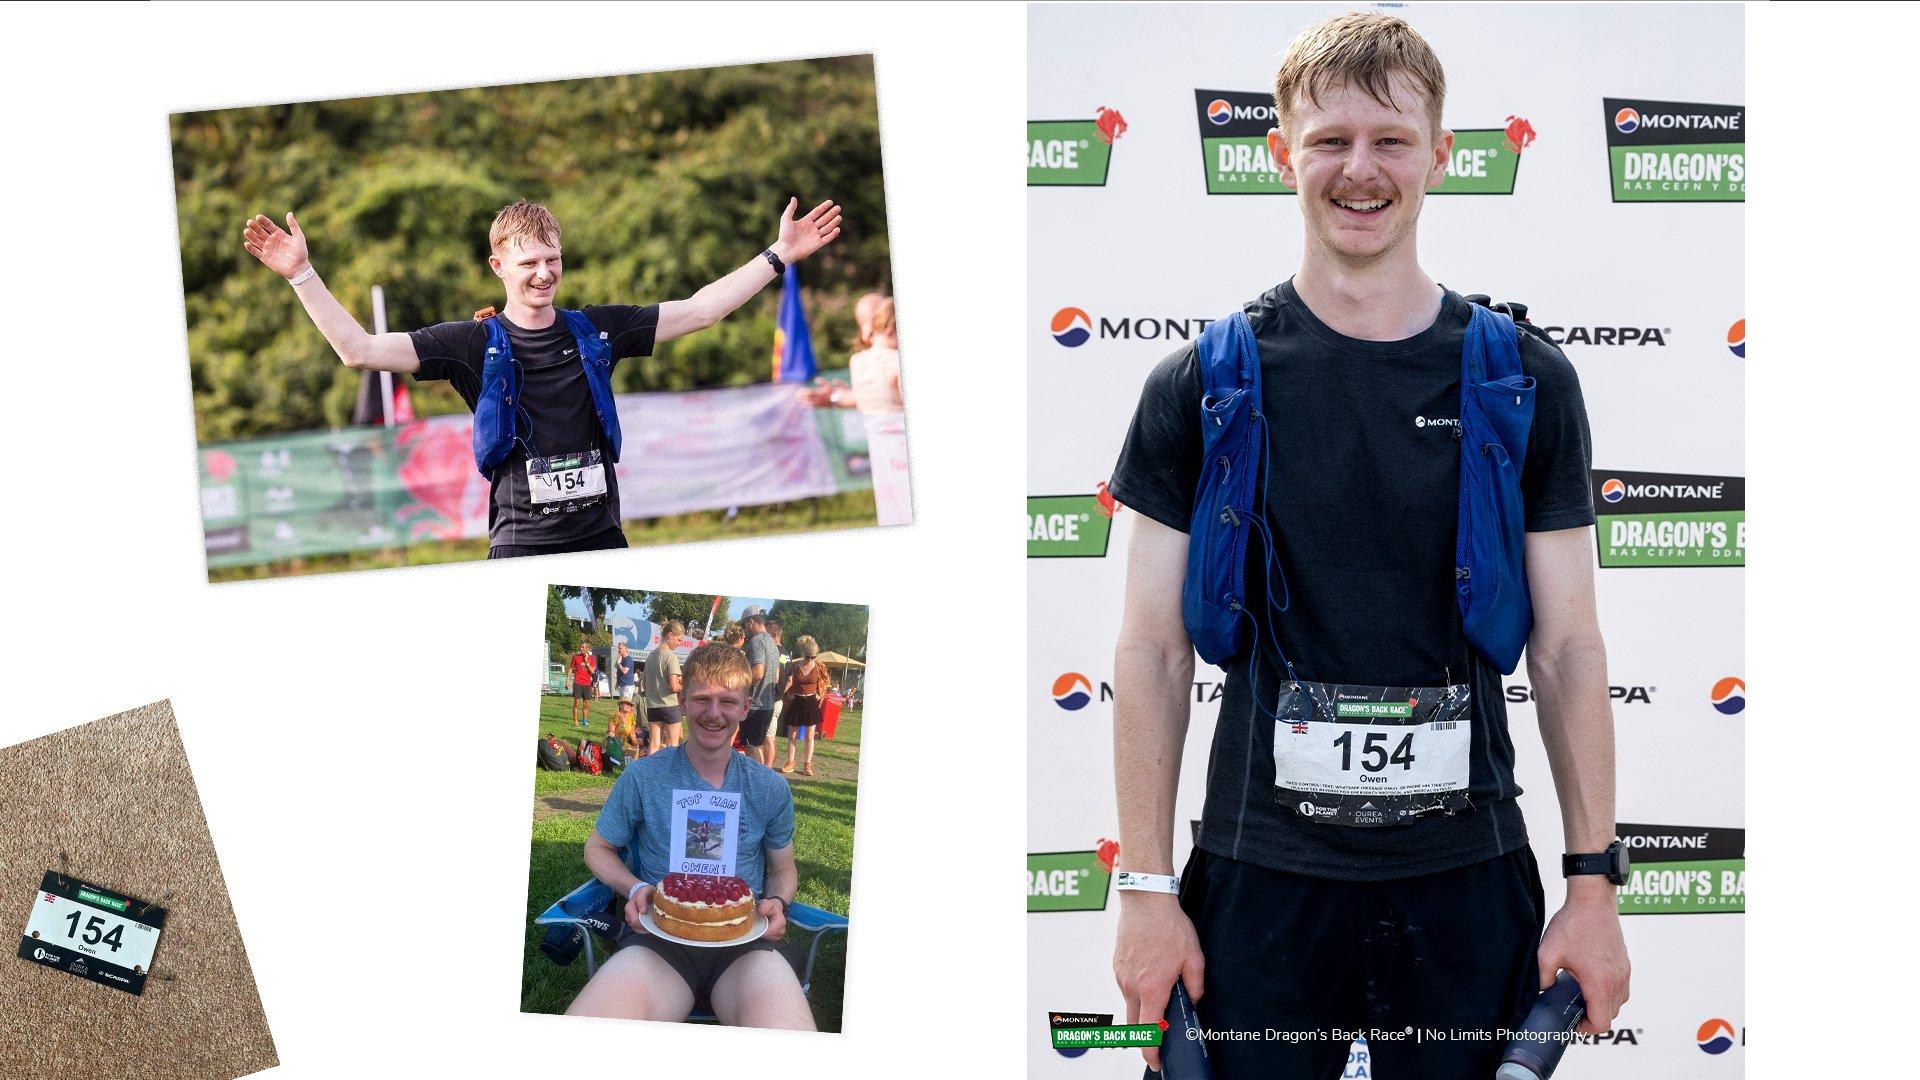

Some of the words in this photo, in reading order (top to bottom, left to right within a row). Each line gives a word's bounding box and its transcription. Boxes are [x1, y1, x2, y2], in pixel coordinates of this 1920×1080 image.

[1624, 152, 1744, 182] DRAGON'S
[1218, 174, 1247, 183] RAS
[1257, 175, 1281, 183] CE
[1624, 181, 1652, 190] RAS
[1662, 181, 1702, 191] CEFN
[1712, 183, 1719, 191] Y
[553, 470, 585, 491] 154
[1610, 520, 1727, 548] DRAGON'S
[1609, 548, 1638, 556] RAS
[1647, 548, 1686, 557] CEFN
[1696, 549, 1703, 557] Y
[1339, 704, 1370, 713] DRAGON'S
[1371, 705, 1388, 714] BACK
[1333, 730, 1415, 771] 154
[1359, 773, 1387, 784] Owen
[677, 794, 702, 809] TOP
[710, 795, 738, 810] MAN
[1617, 870, 1713, 896] AGON'S
[1634, 896, 1672, 904] CEFN
[66, 909, 125, 953] 154
[78, 943, 96, 956] Owen
